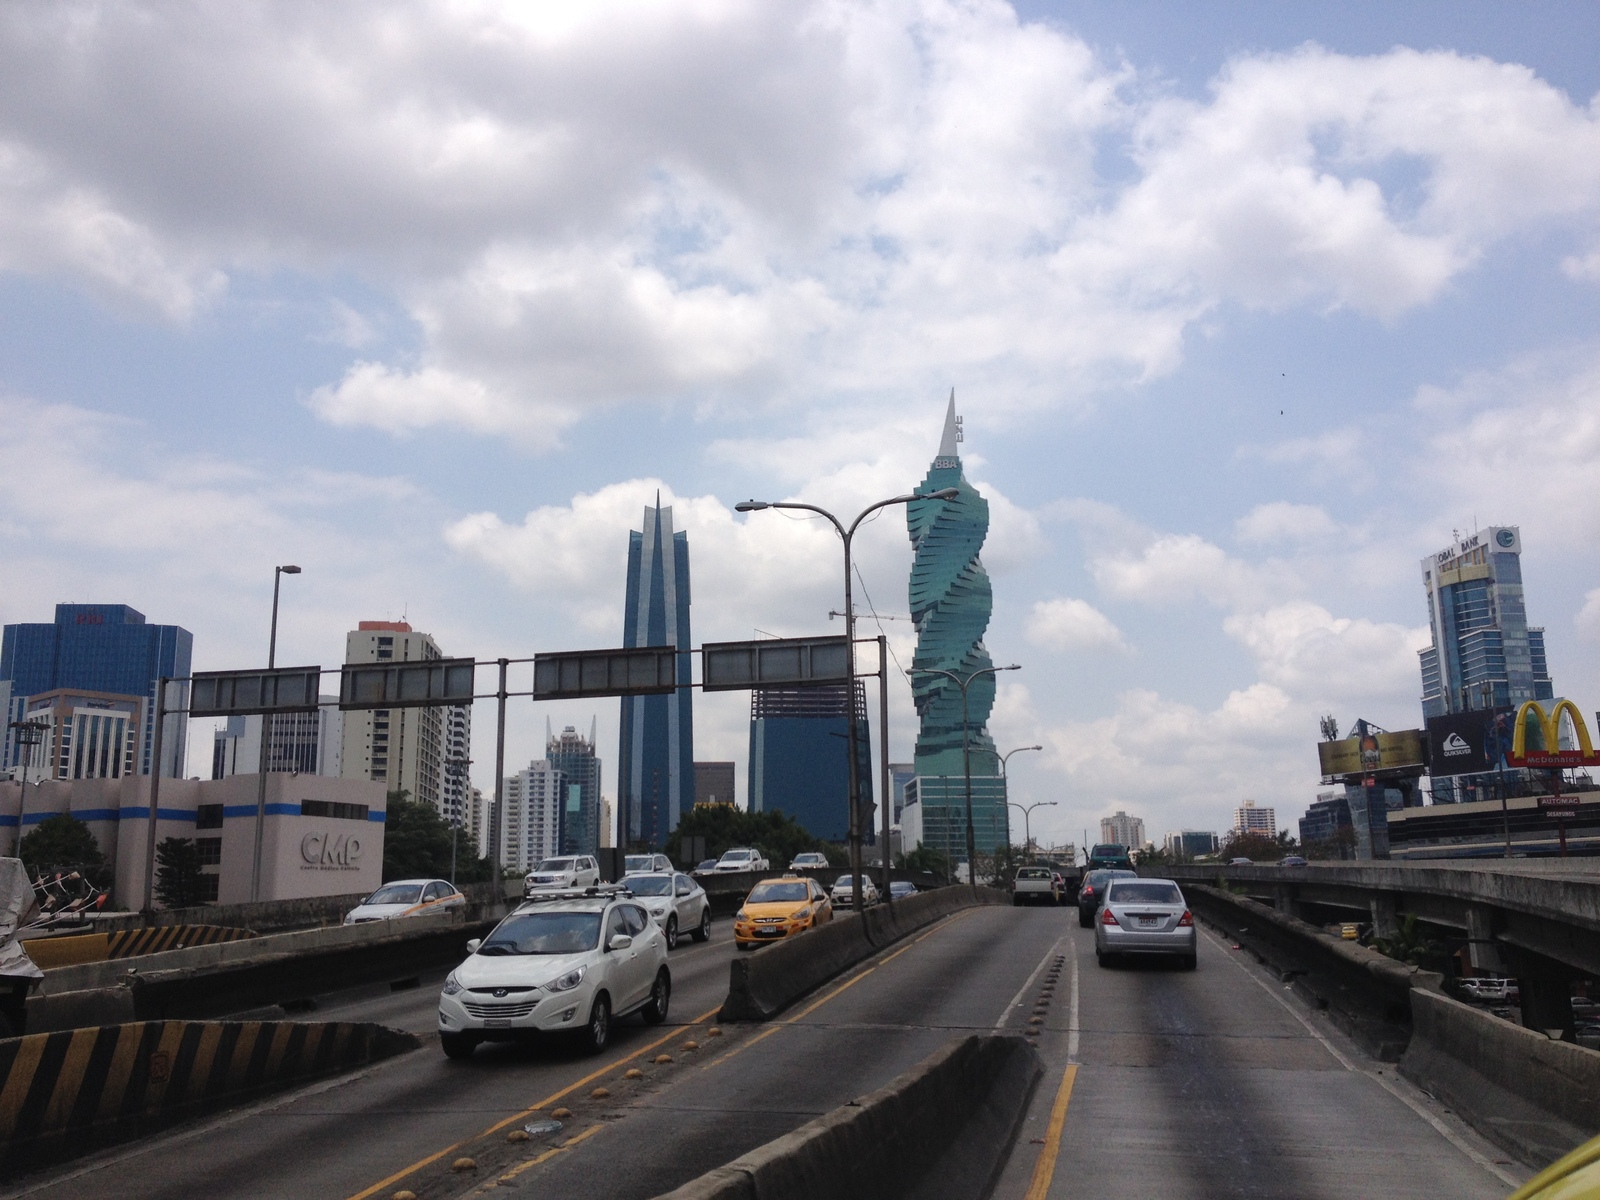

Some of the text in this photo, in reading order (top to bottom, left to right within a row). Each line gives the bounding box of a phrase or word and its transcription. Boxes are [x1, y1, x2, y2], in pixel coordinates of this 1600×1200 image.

[1461, 536, 1480, 552] BANK
[1527, 756, 1582, 764] McDonald's
[301, 831, 363, 865] CMP
